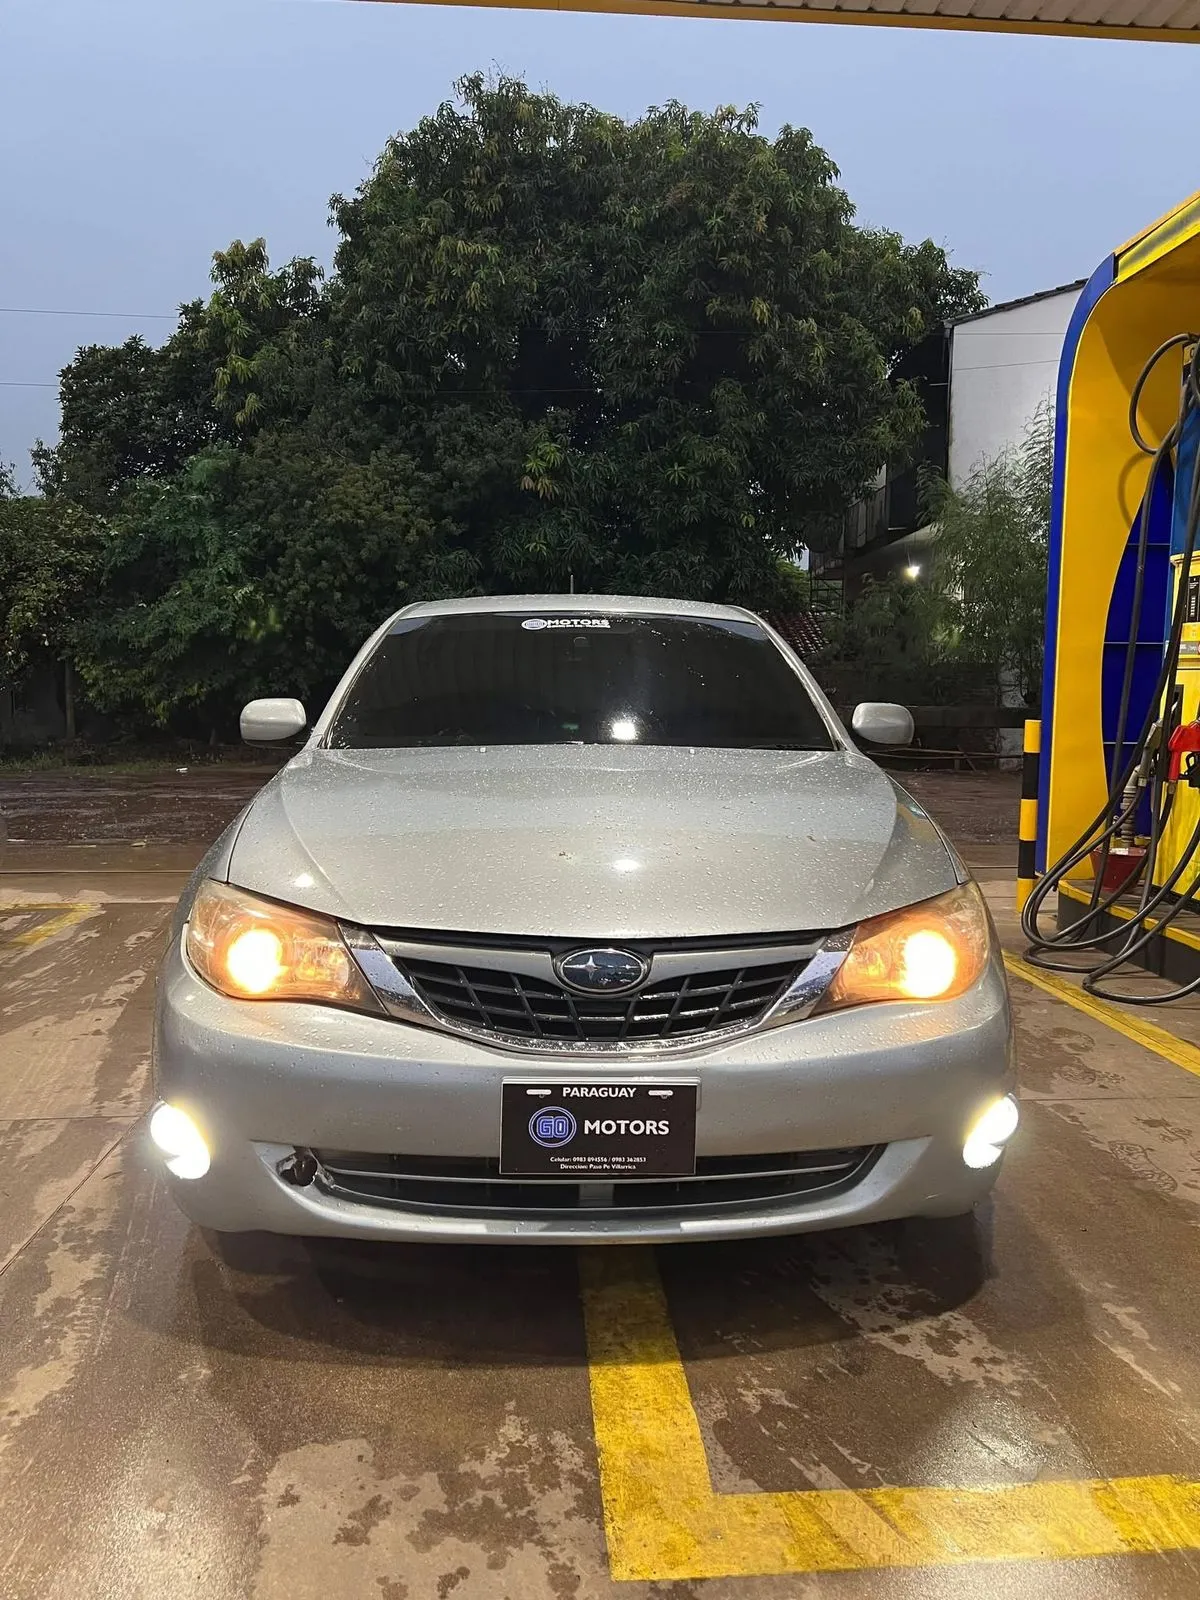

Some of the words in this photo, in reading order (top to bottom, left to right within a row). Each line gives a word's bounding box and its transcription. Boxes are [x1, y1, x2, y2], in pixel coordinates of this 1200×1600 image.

[562, 1087, 637, 1098] PARAGUAY
[536, 1116, 569, 1138] GO
[584, 1120, 670, 1135] MOTORS
